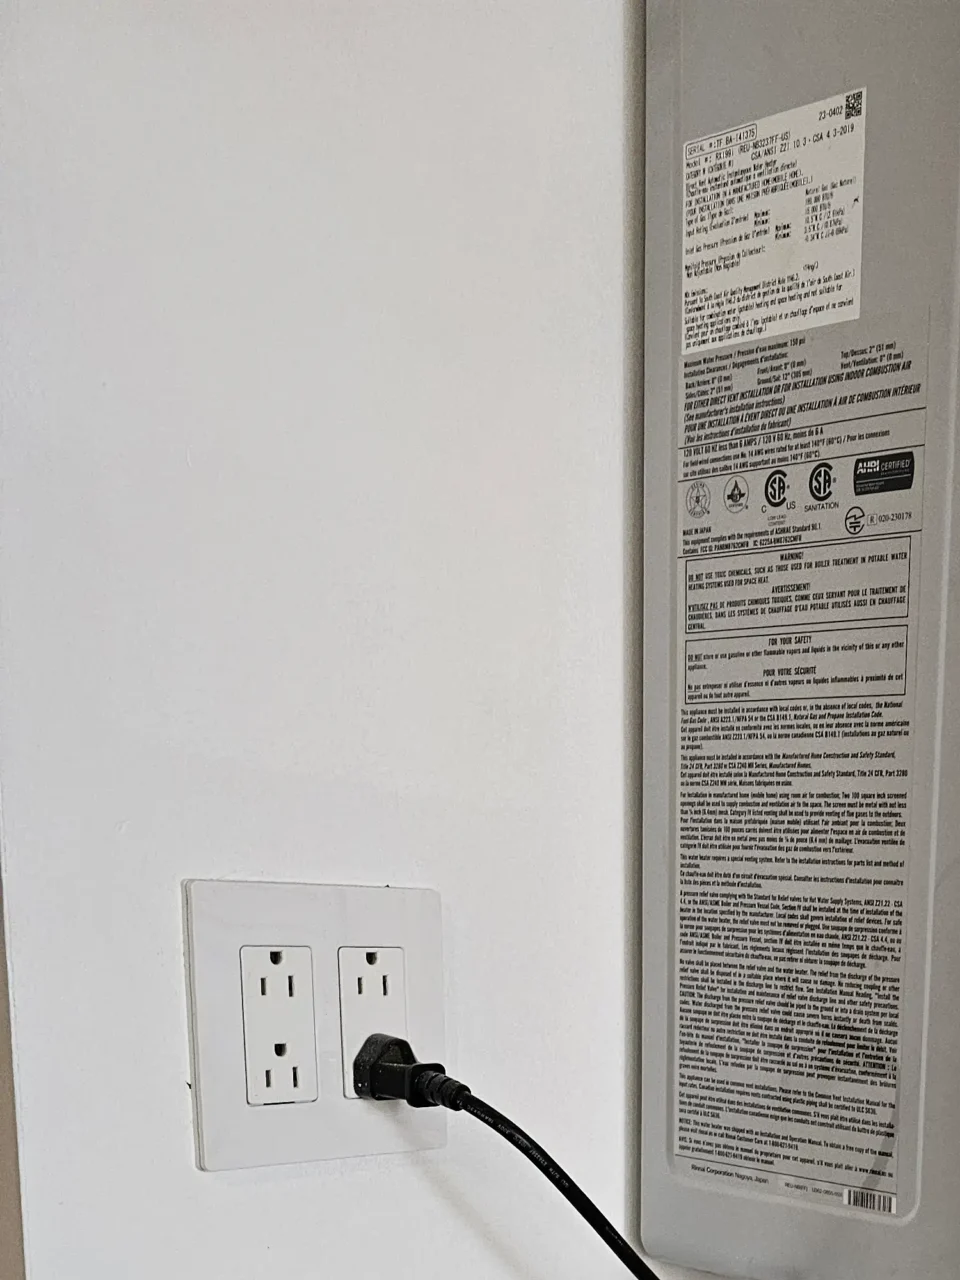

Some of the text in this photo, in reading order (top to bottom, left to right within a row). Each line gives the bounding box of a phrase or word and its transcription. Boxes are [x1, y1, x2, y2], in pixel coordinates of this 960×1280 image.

[818, 106, 843, 121] 23-0402
[739, 386, 774, 401] INSTALLATION
[781, 382, 792, 394] FOR
[792, 376, 828, 392] INSTALLATION
[866, 362, 901, 378] COMBUSTION
[902, 360, 912, 372] AIR
[804, 501, 839, 513] SANITATION
[832, 558, 858, 567] TREATMENT
[868, 555, 888, 564] POTABLE
[891, 553, 907, 562] WATER
[706, 1167, 734, 1178] Corporation
